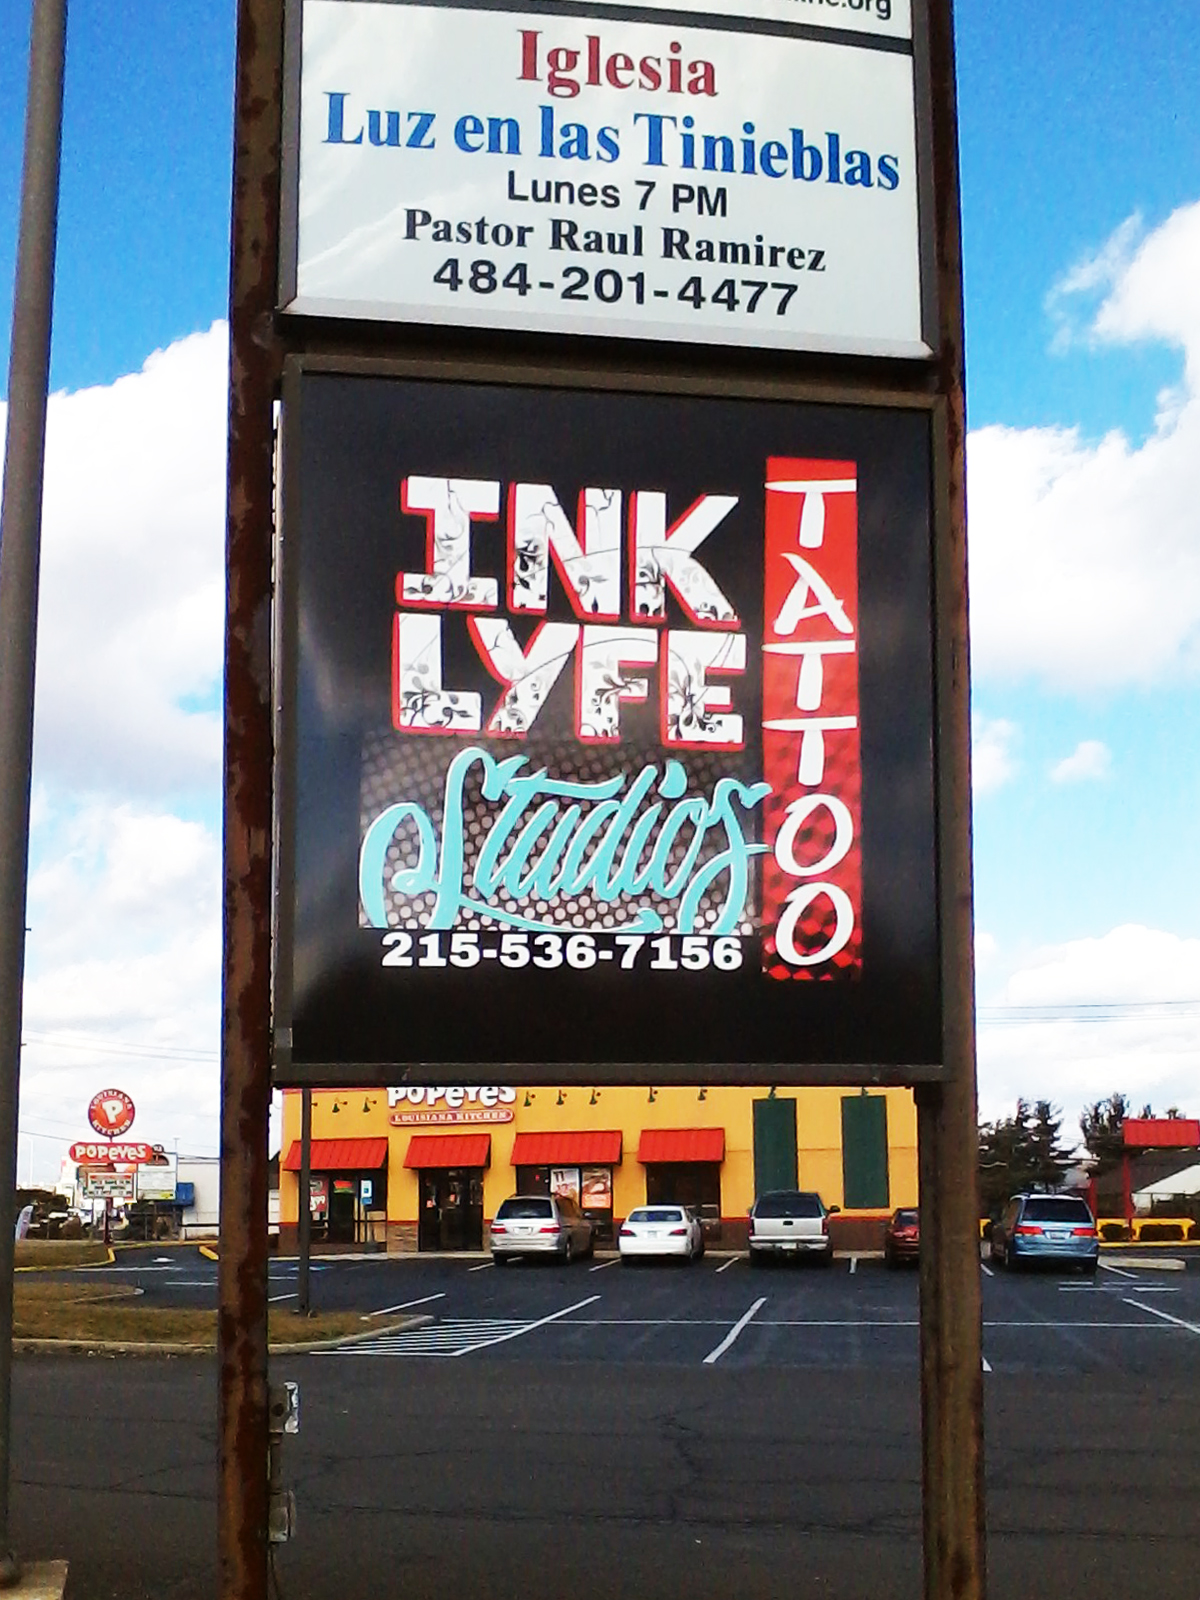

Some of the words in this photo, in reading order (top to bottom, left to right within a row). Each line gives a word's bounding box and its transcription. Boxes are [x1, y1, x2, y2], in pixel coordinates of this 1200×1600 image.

[516, 29, 718, 97] Iglesia
[322, 91, 436, 149] Luz
[454, 115, 521, 155] en
[538, 105, 620, 163] las
[633, 112, 900, 190] Tinieblas
[508, 170, 620, 208] Lunes
[635, 180, 656, 210] 7
[672, 184, 728, 217] PM
[402, 208, 534, 248] Pastor
[549, 218, 643, 257] Raul
[660, 226, 827, 271] Ramirez
[433, 258, 798, 315] 484-201-4477
[398, 476, 741, 628] INK
[393, 612, 748, 751] LYFE
[761, 479, 857, 966] TATTOO
[380, 932, 743, 971] 215-536-7156
[395, 1112, 453, 1122] LOUISIANA
[456, 1110, 507, 1120] KITCHEN
